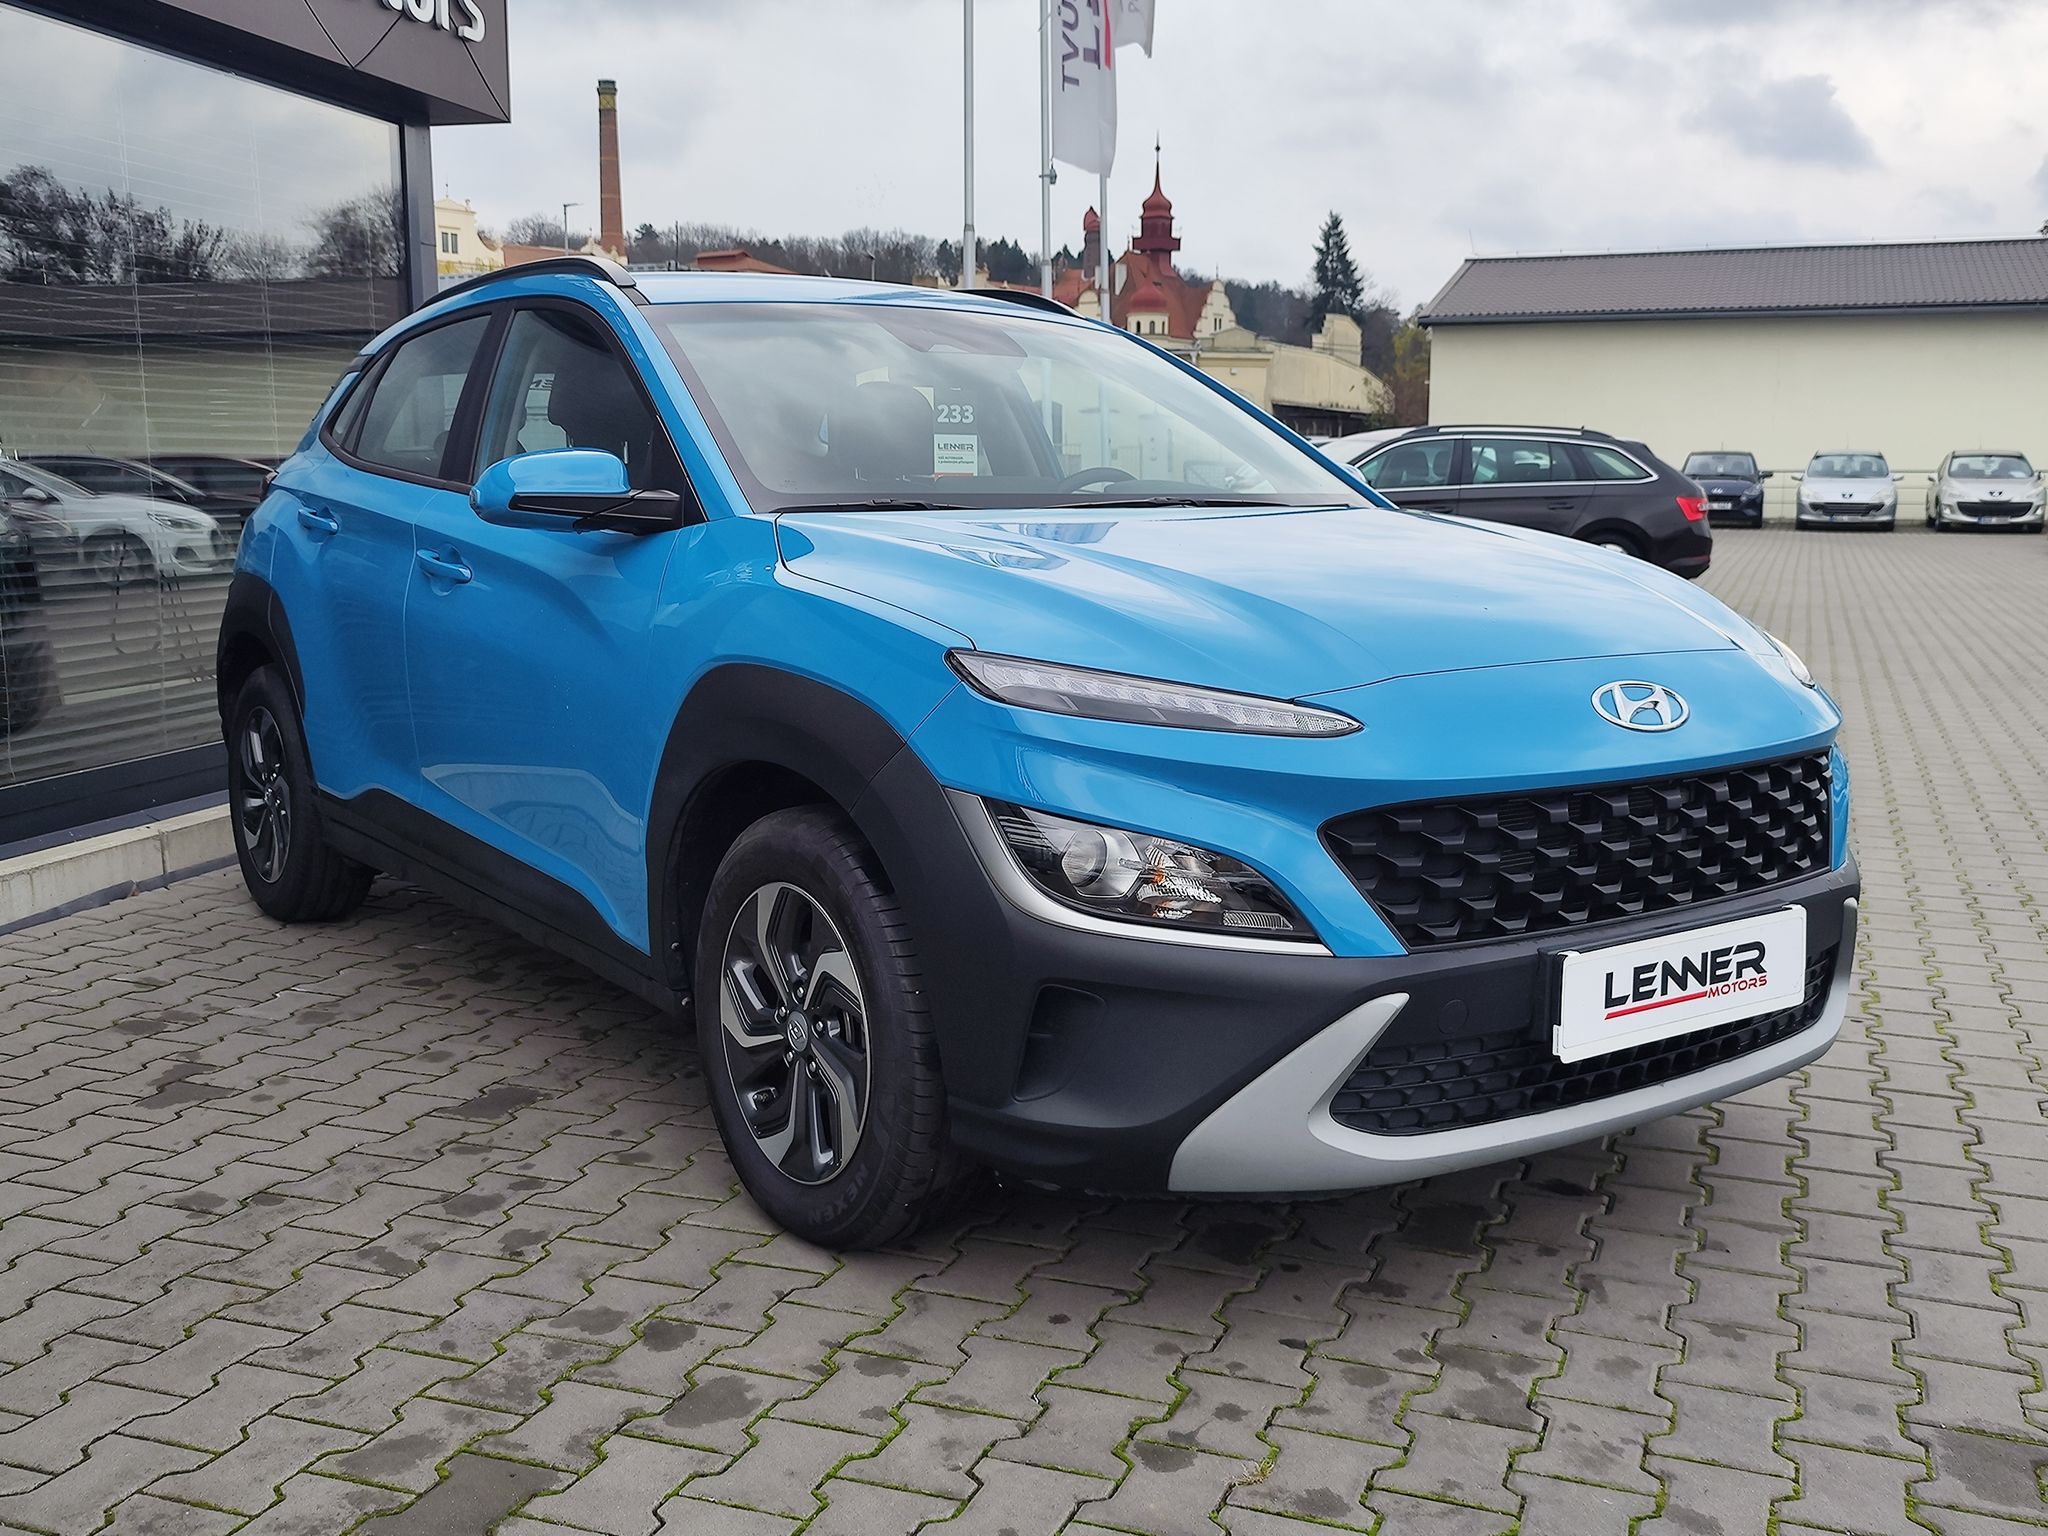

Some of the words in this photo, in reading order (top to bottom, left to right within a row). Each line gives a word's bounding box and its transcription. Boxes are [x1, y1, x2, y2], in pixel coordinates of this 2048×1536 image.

[937, 405, 974, 423] 233
[937, 443, 974, 451] LENNER
[1604, 941, 1766, 1010] LENNER
[1708, 974, 1767, 998] MOTORS
[807, 1162, 869, 1225] NEXEN
